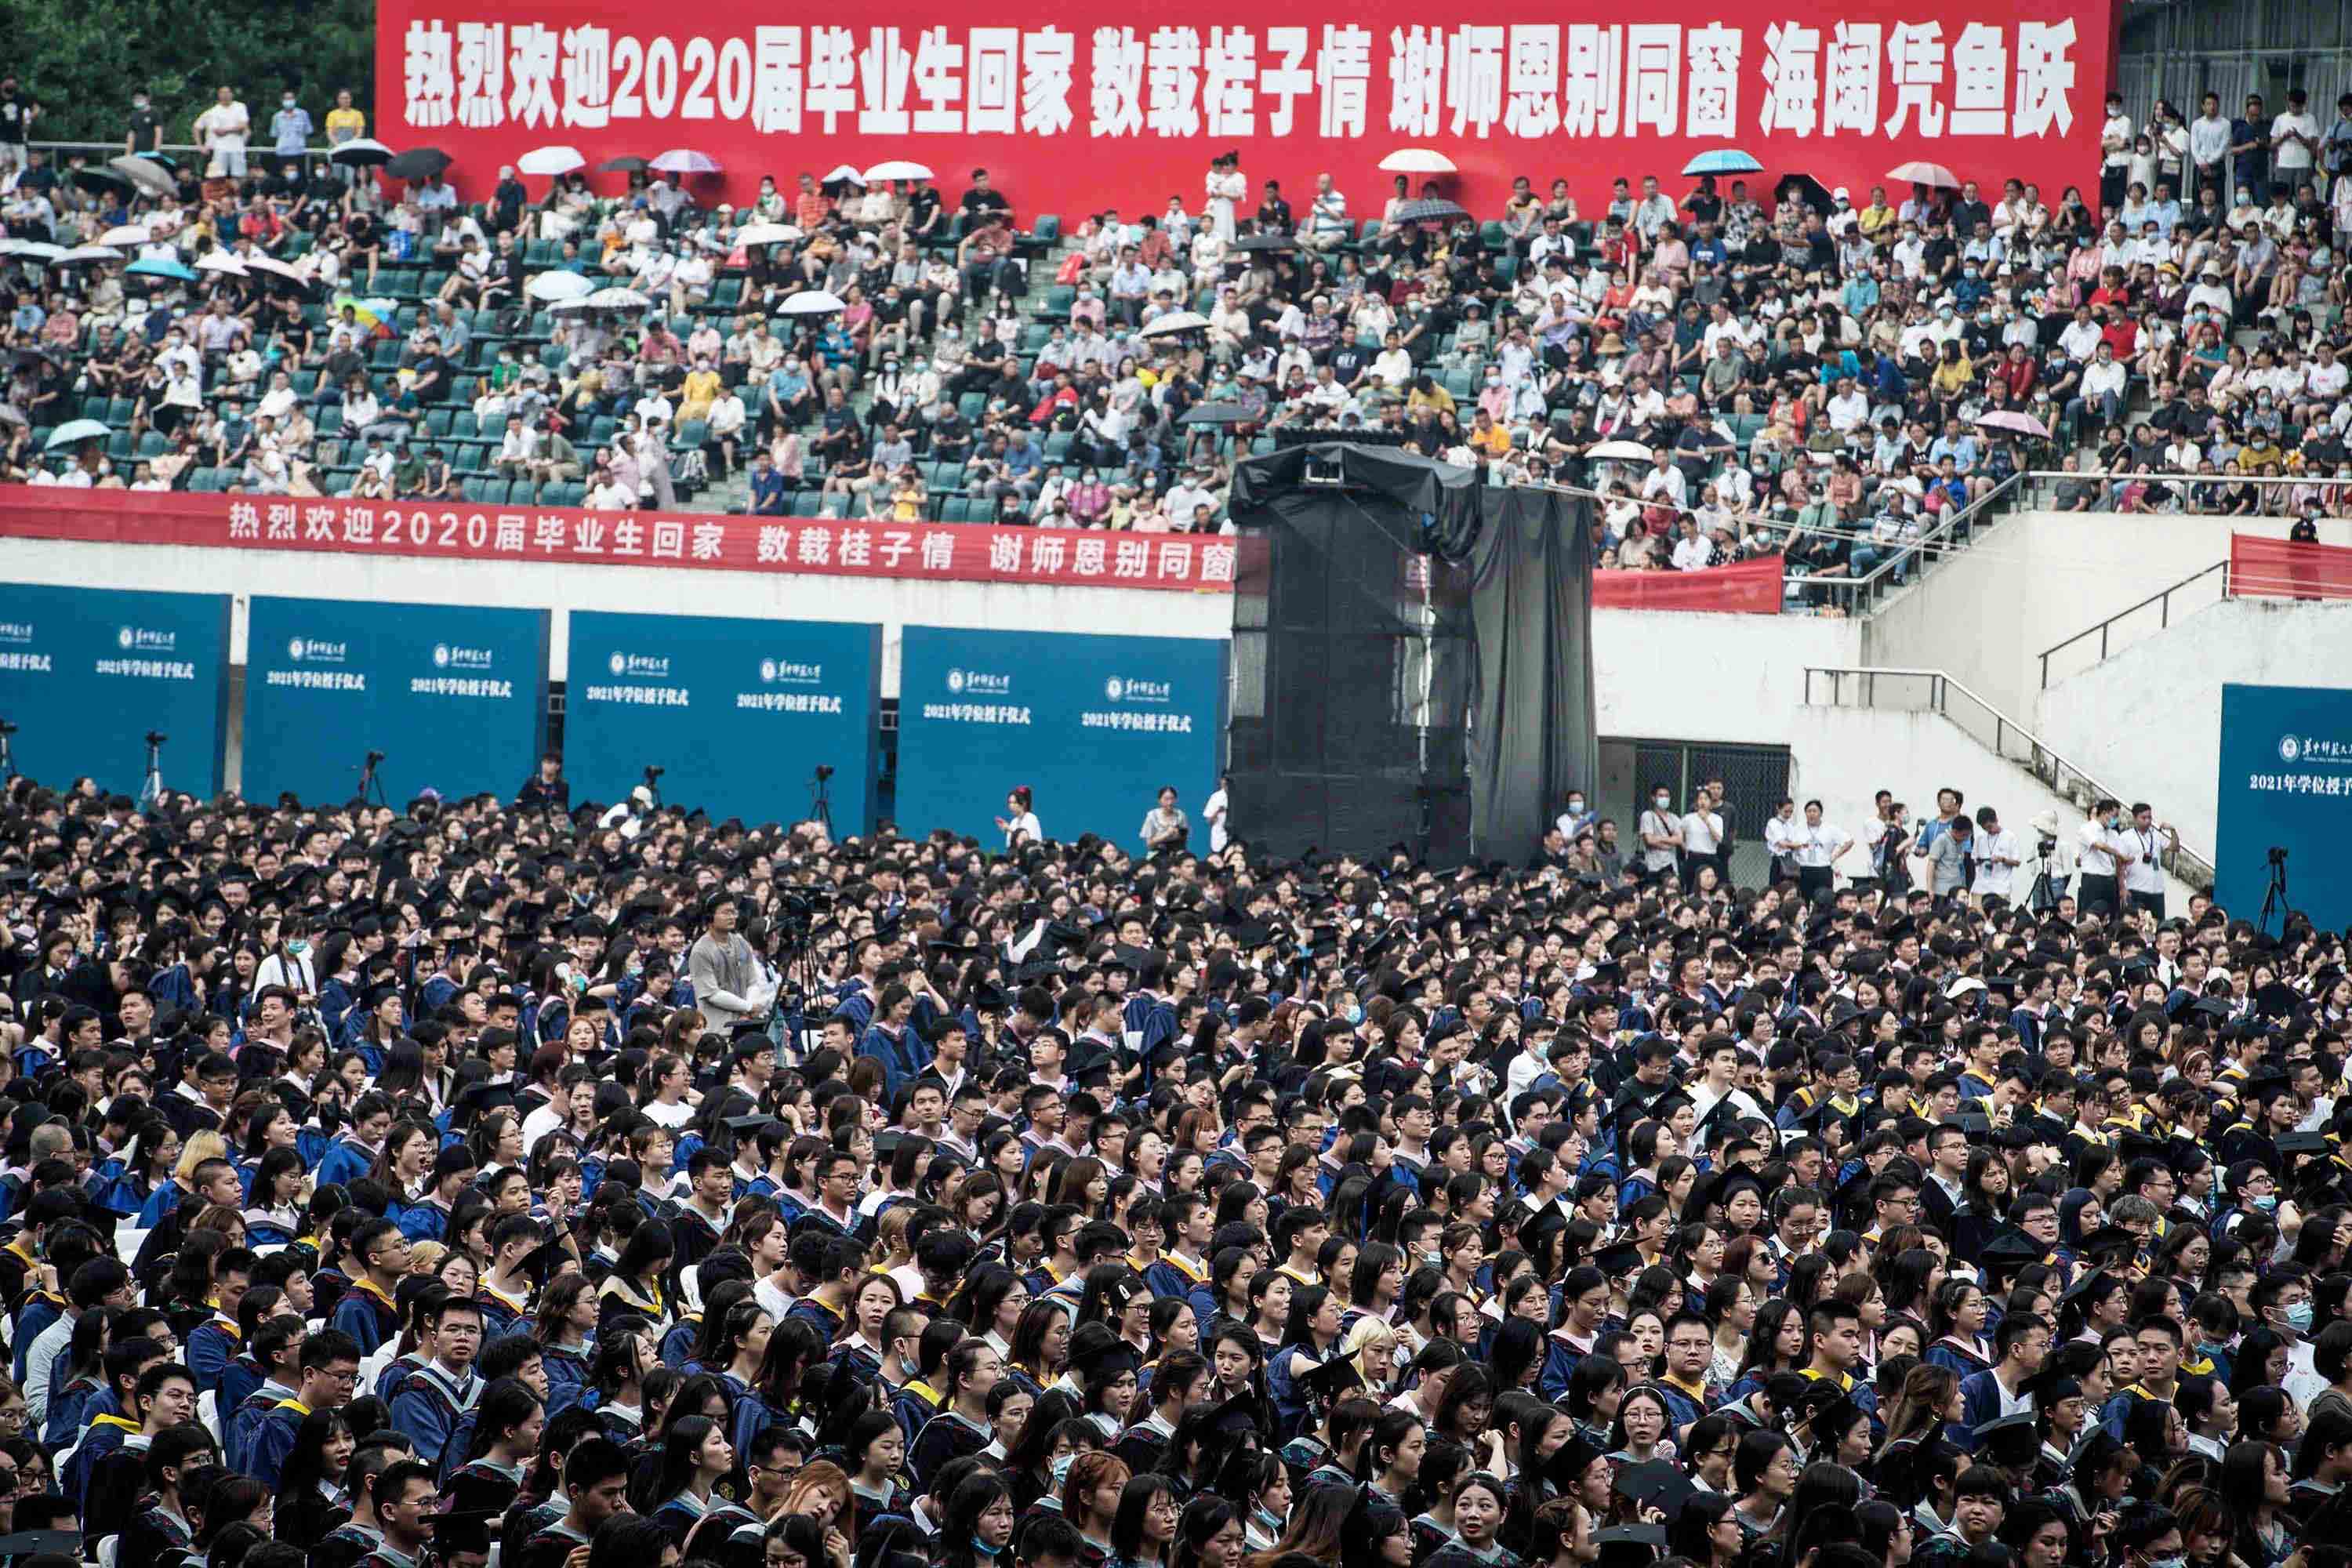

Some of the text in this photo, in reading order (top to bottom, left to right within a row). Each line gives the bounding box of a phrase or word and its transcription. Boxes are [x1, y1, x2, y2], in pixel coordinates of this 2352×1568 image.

[403, 16, 2078, 140] 热烈欢迎2020届毕业生回家 数载桂子情 谢师恩别同窗 海阔凭鱼跃
[229, 501, 1234, 583] 热烈欢迎2020届毕业生回家 数载桂子情 谢师恩别同窗
[923, 703, 1032, 725] 2021年学位授予仪式
[1081, 711, 1192, 733] 2021年学位授予仪式
